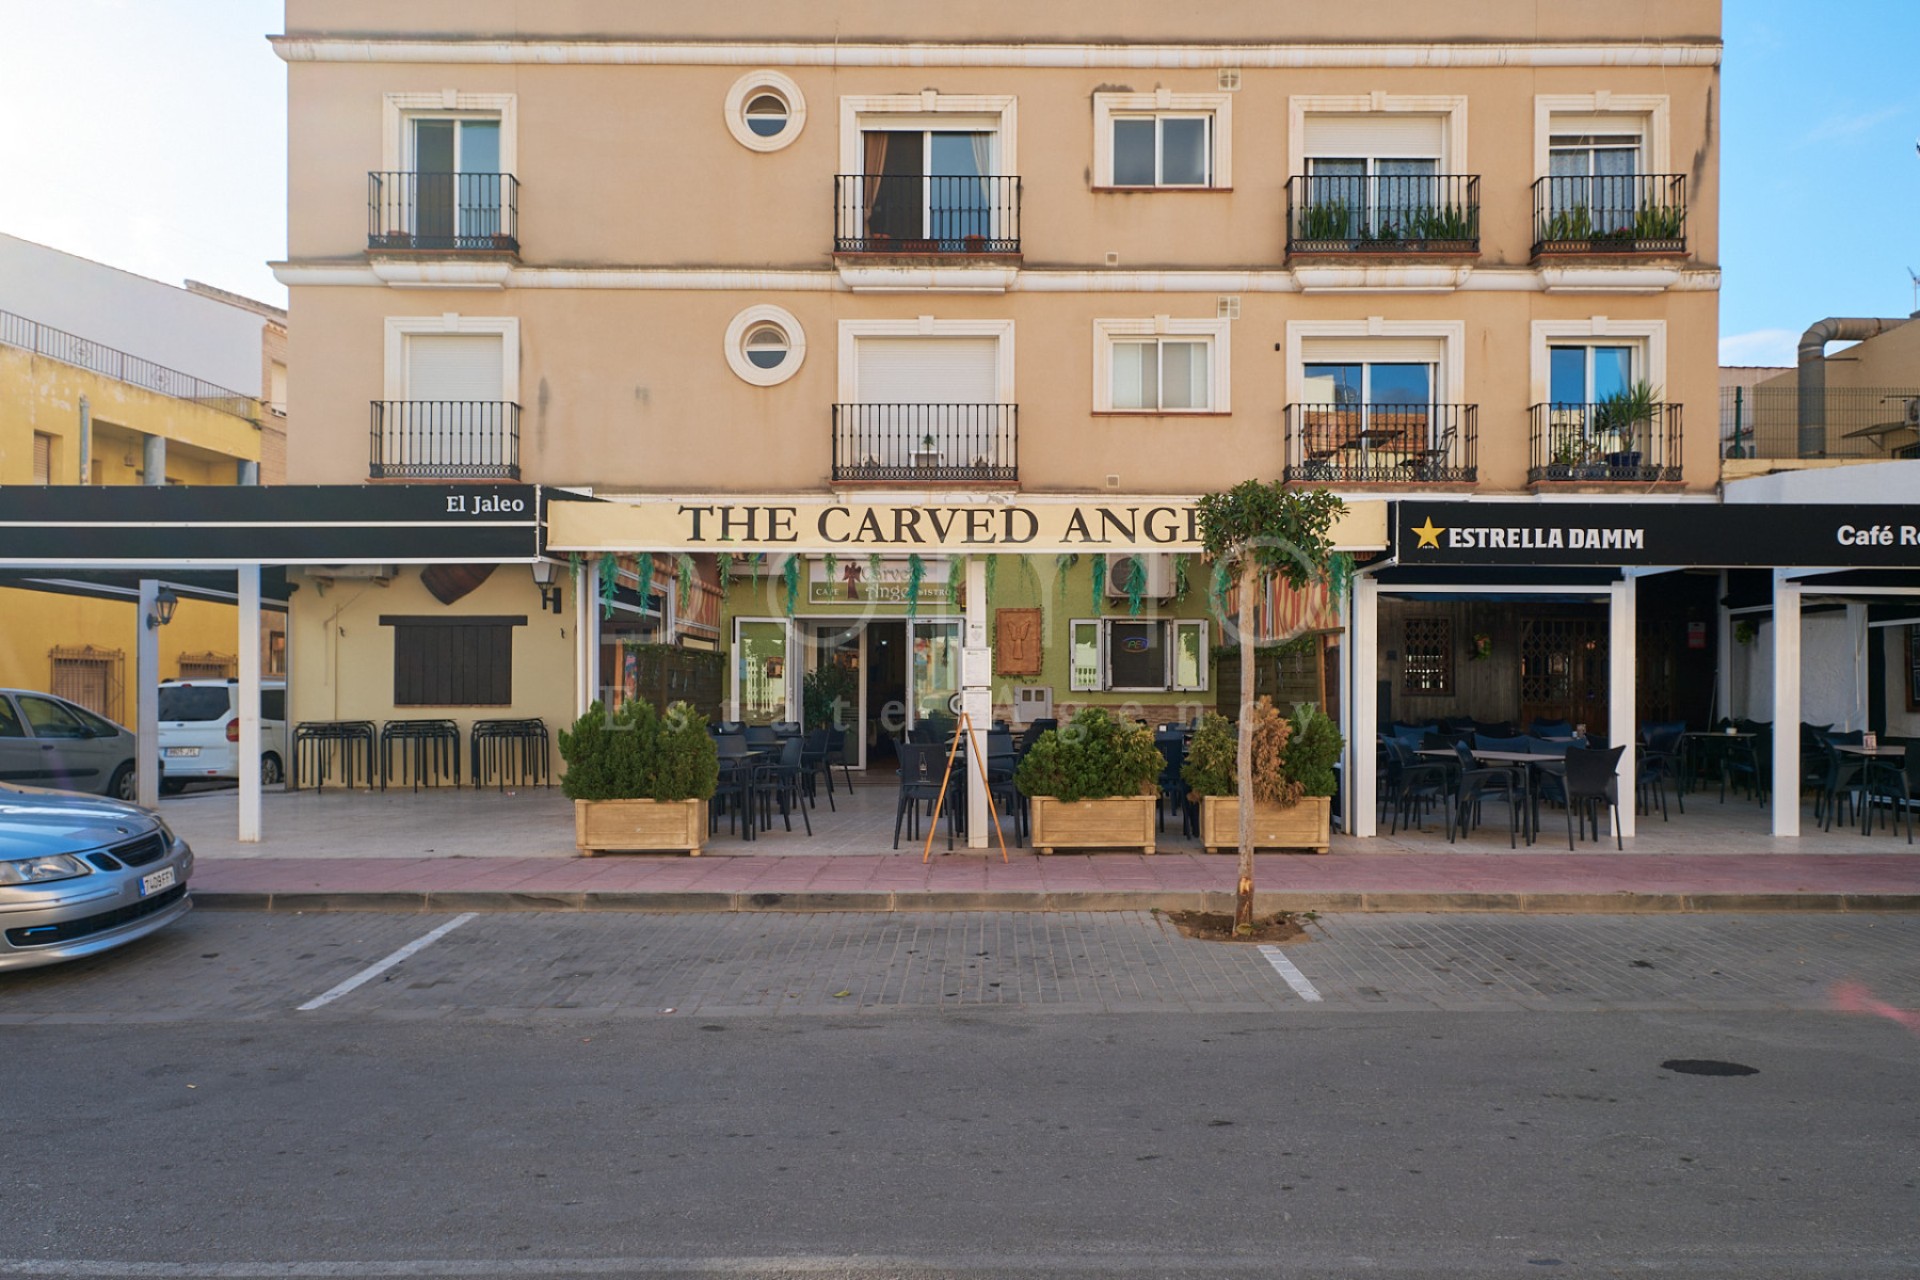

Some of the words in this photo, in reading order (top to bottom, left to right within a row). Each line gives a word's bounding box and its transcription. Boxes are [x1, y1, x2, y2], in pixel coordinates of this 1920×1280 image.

[446, 495, 466, 512] El
[471, 495, 525, 515] Jaleo
[677, 504, 799, 543] THE
[817, 506, 1040, 545] CARVED
[1059, 507, 1206, 544] ANGE
[1448, 527, 1564, 549] ESTRELLA
[1568, 528, 1644, 549] DAMM
[1837, 525, 1894, 546] Café
[1900, 525, 1920, 546] R
[861, 565, 919, 582] Crve
[865, 584, 916, 602] Ange
